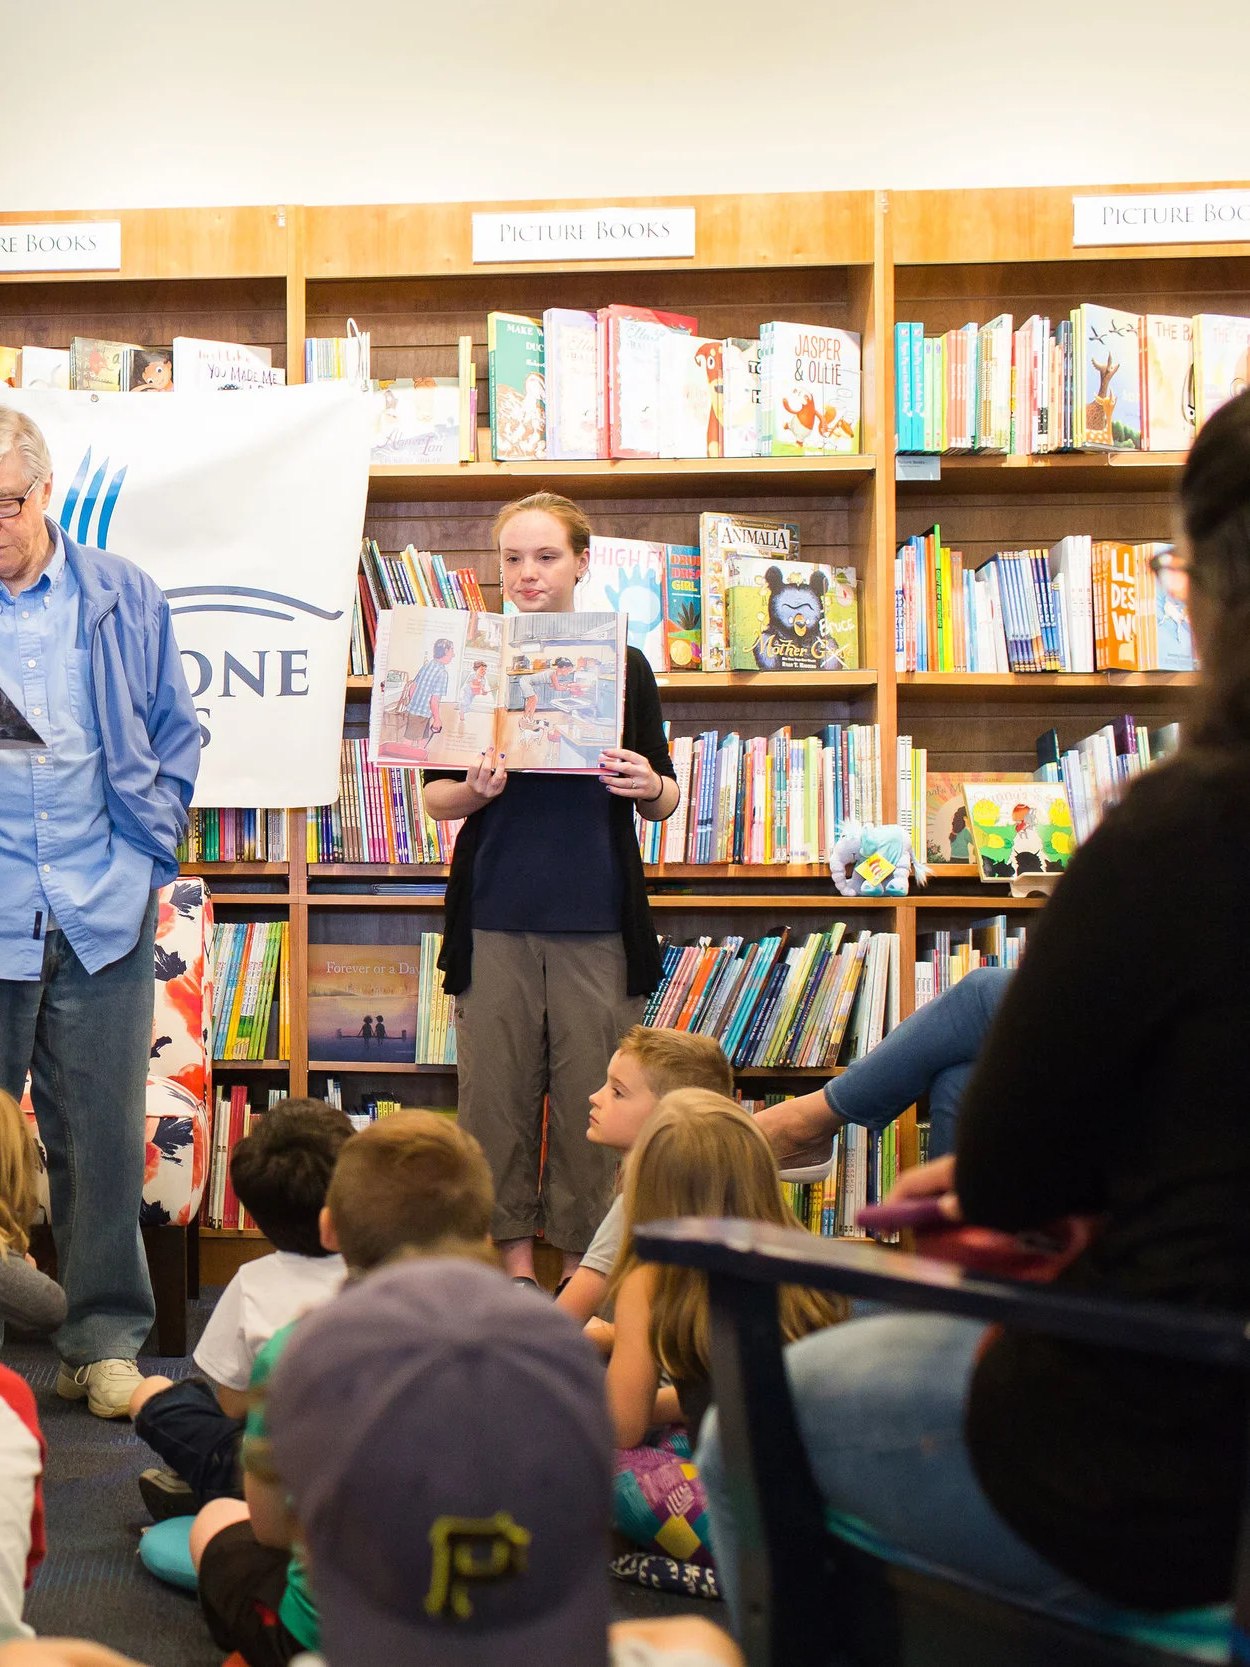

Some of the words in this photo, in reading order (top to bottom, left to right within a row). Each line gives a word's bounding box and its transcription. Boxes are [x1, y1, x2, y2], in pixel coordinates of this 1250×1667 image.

[1103, 206, 1194, 225] PICTURE
[27, 233, 97, 251] BOOKS
[500, 223, 586, 242] PICTURE
[597, 220, 670, 240] BOOKS
[507, 323, 534, 336] MAKE
[795, 334, 841, 361] JASPER
[794, 358, 804, 381] &
[808, 360, 842, 386] OLLIE
[721, 526, 788, 550] ANIMALIA
[594, 545, 641, 567] HIGH
[671, 580, 698, 592] GIRL
[743, 631, 807, 658] Mother
[326, 961, 369, 974] Forever
[373, 964, 384, 974] or
[389, 965, 395, 974] a
[424, 1511, 532, 1619] P
